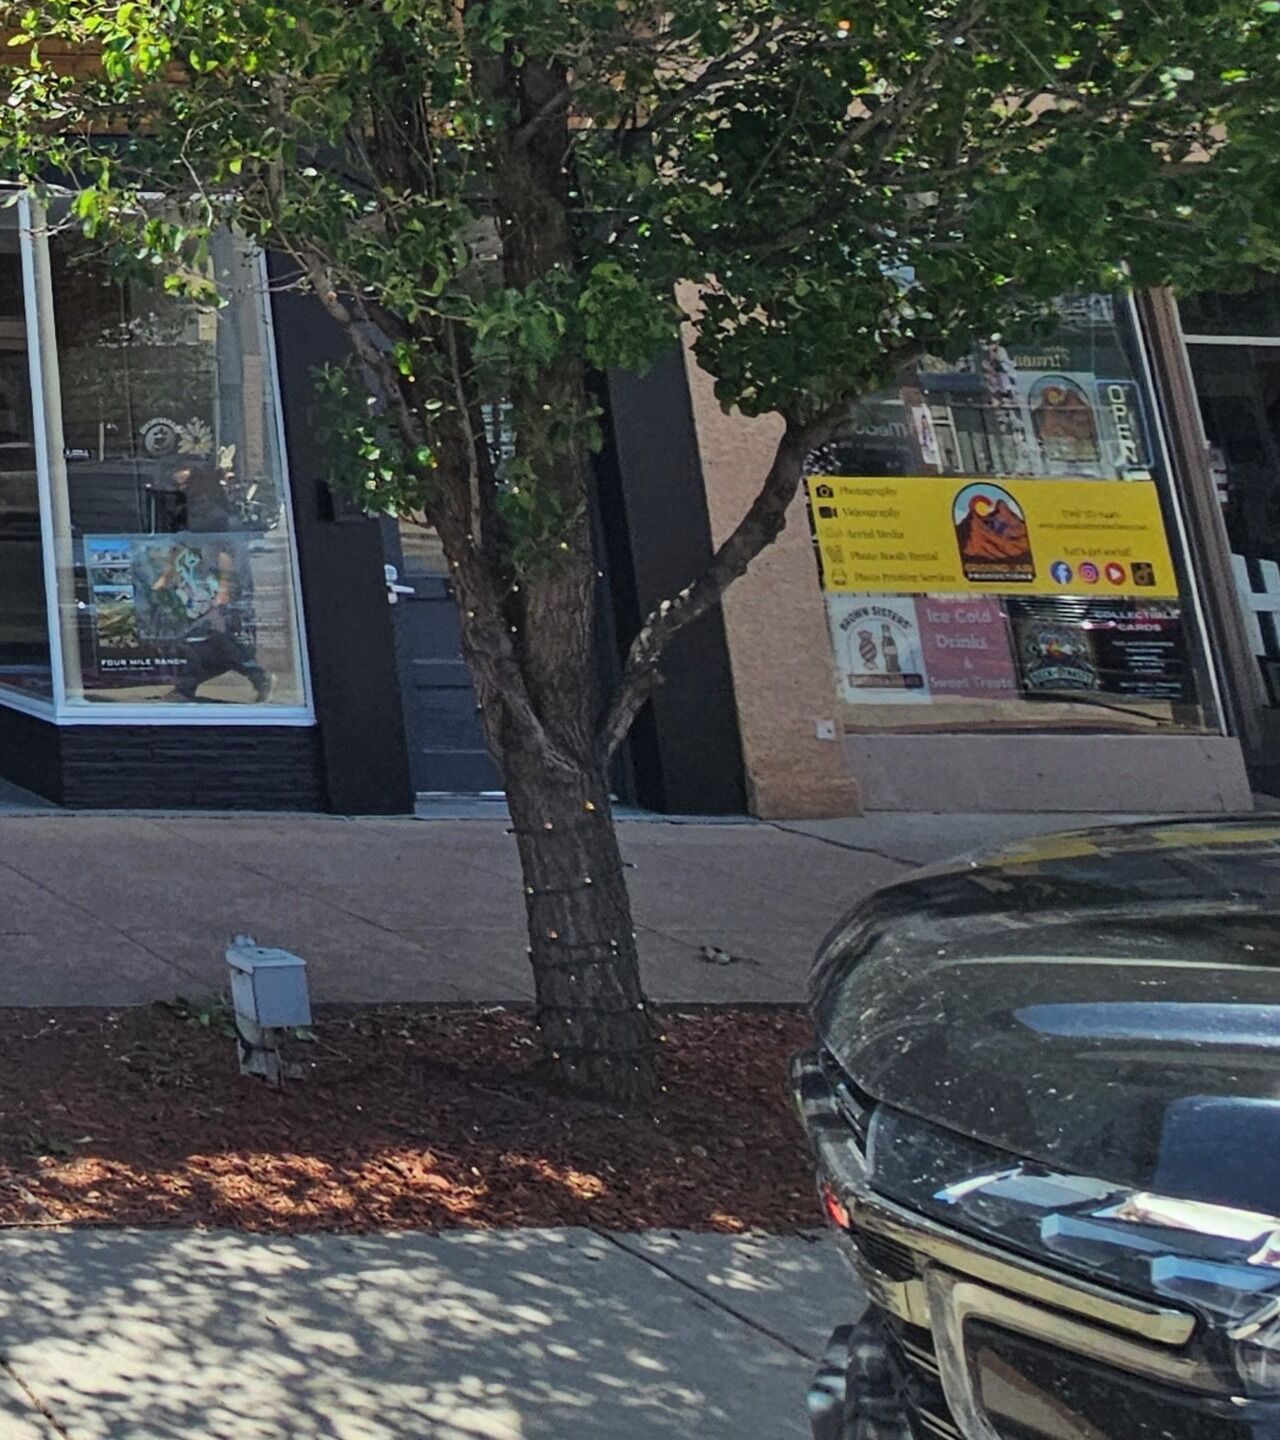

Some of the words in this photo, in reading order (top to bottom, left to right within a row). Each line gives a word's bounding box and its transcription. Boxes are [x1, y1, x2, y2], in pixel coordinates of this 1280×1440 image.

[1107, 384, 1138, 464] OPEN
[839, 607, 869, 632] BROWN
[927, 609, 950, 623] Ice
[954, 609, 991, 623] Cold
[1117, 623, 1161, 632] CARDS
[936, 634, 988, 649] Drinks
[130, 658, 151, 666] MILE
